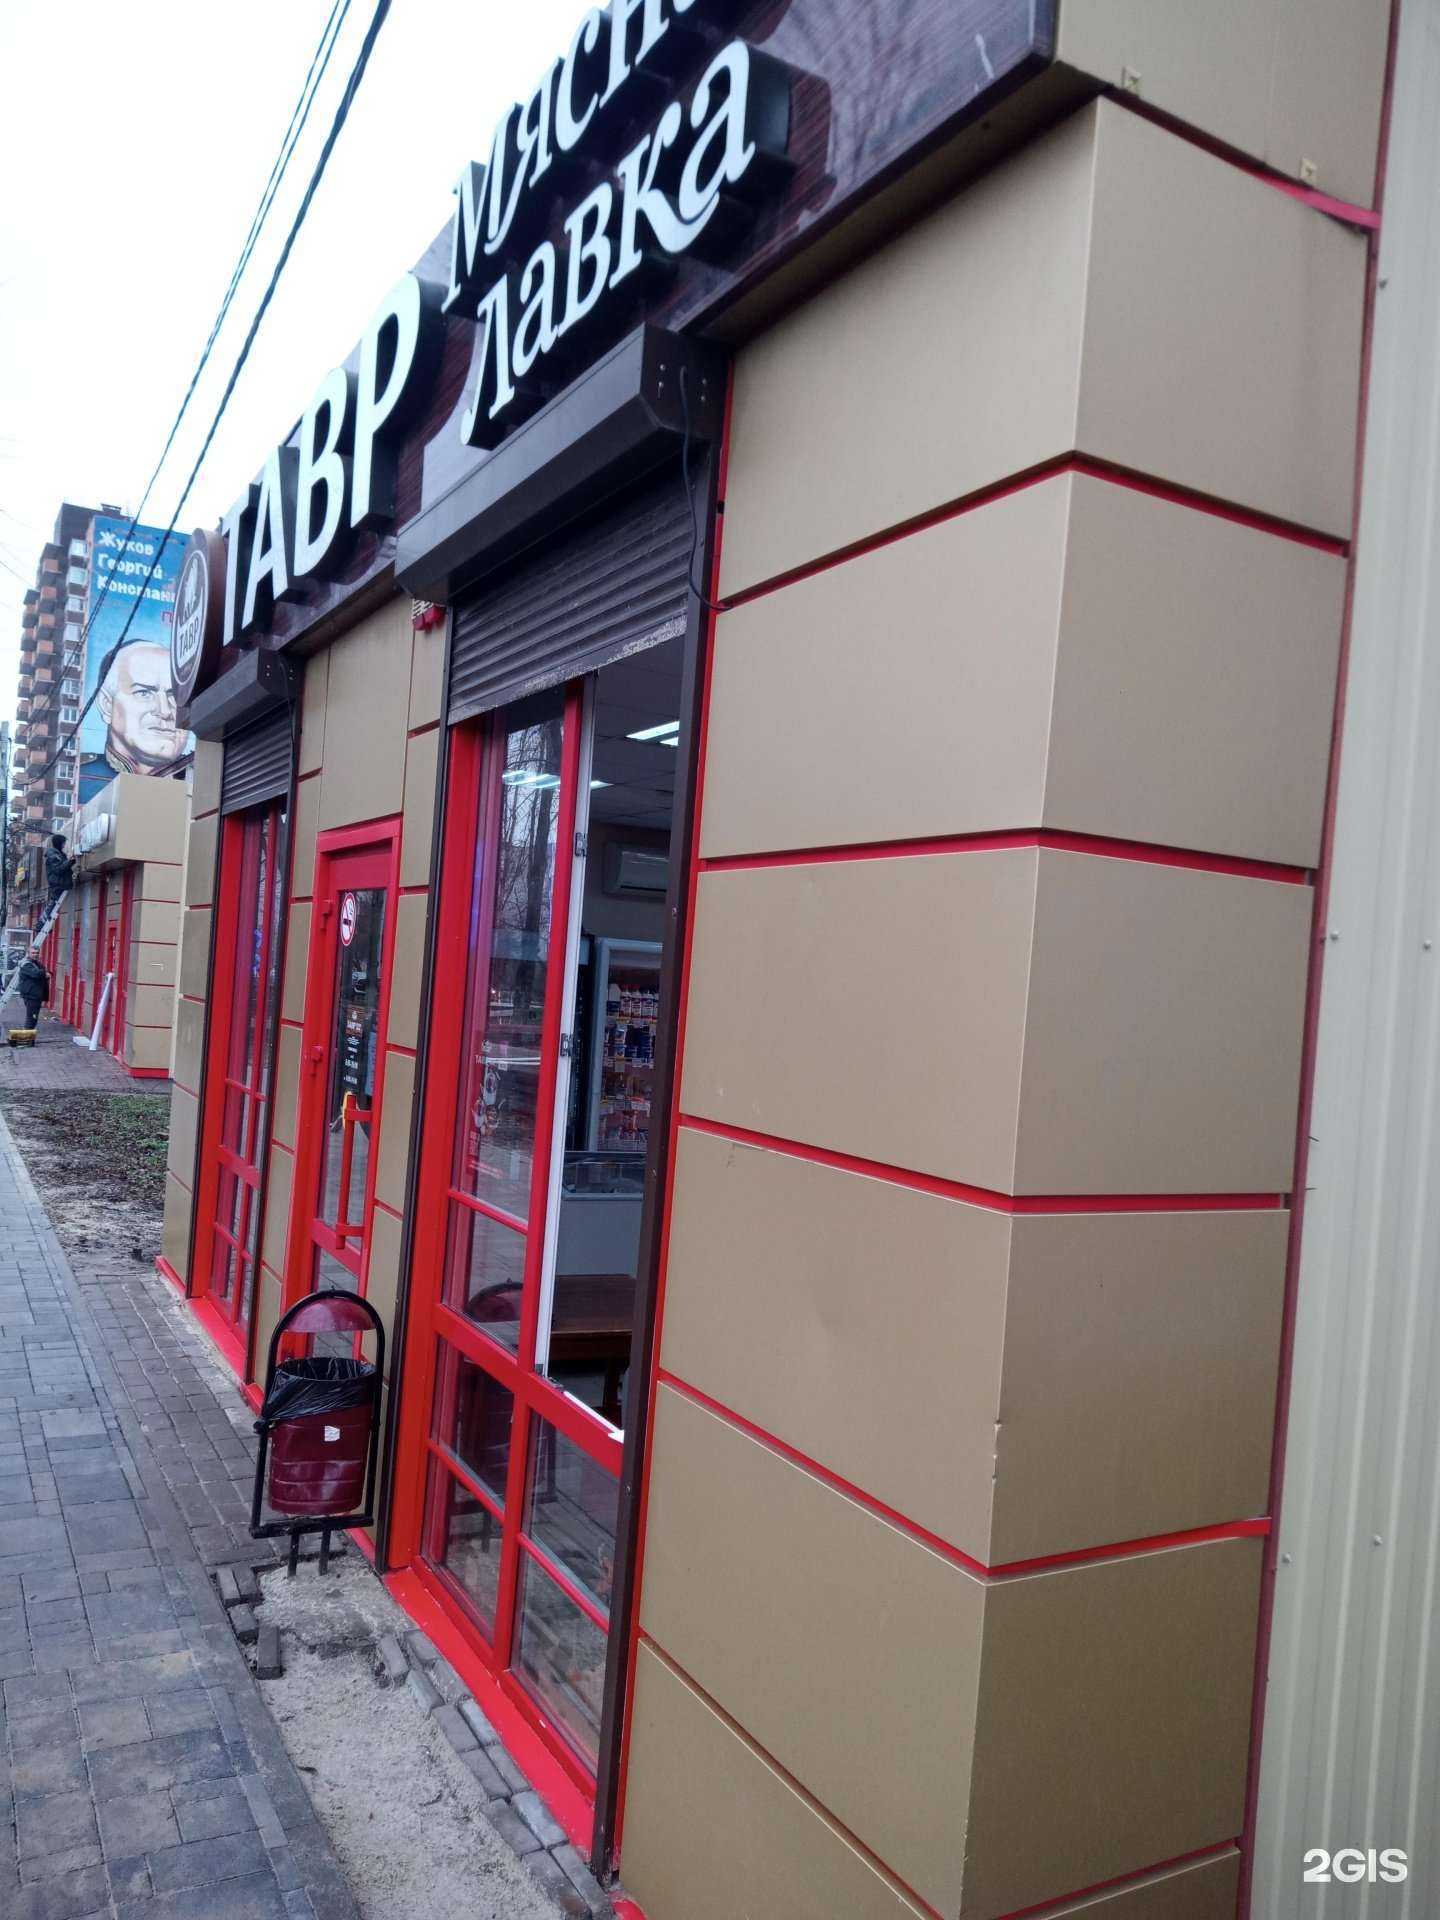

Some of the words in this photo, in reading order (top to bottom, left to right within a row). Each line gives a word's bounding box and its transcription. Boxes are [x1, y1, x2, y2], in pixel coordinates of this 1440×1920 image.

[441, 0, 698, 313] Мясн
[460, 38, 756, 446] Лавка
[220, 270, 421, 648] ТАВР
[98, 531, 155, 556] Жуков
[97, 553, 164, 580] Георгий
[96, 575, 176, 603] Констан
[179, 616, 199, 660] ТАВР
